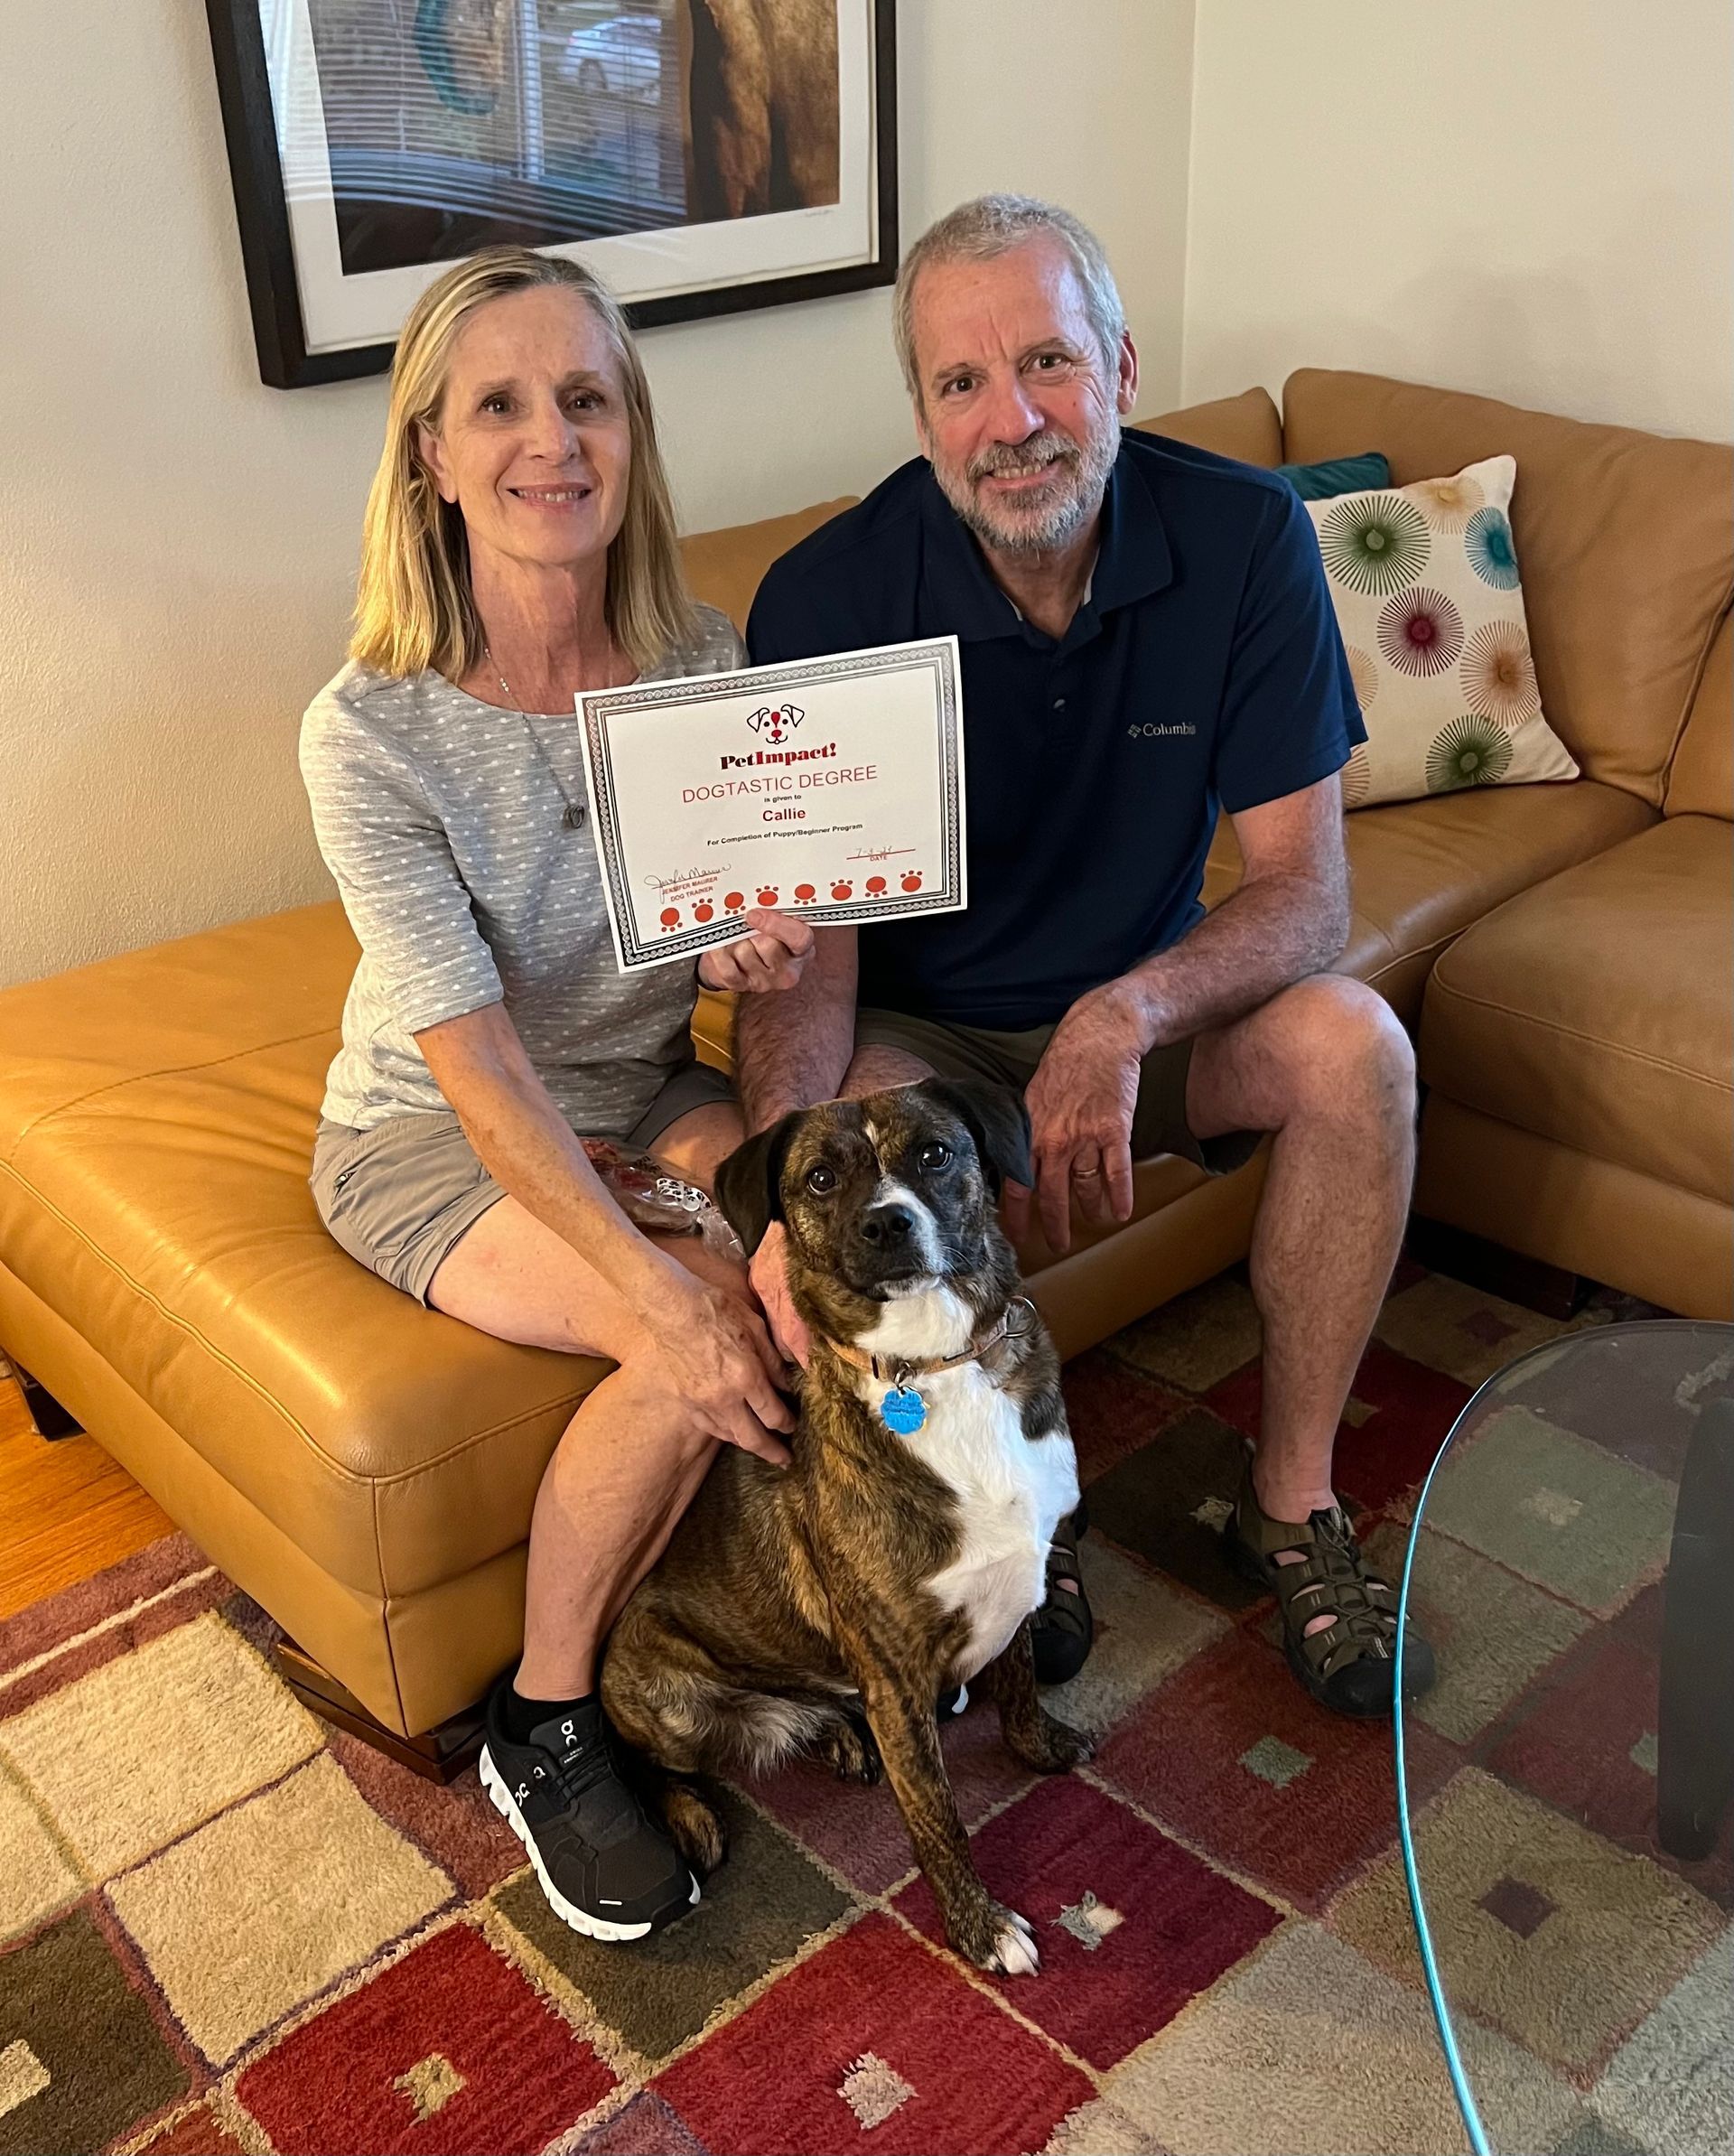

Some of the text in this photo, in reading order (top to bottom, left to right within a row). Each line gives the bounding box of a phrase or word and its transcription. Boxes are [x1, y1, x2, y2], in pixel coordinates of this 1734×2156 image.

[1142, 722, 1196, 736] Columbia
[720, 742, 836, 770] PetImpact!
[683, 765, 878, 803] DOGTASTIC DEGREE
[772, 795, 793, 803] given
[762, 808, 806, 822] Callie
[722, 833, 762, 845] Completion
[773, 827, 830, 838] Puppy/Beginner
[833, 823, 862, 833] Program
[670, 886, 713, 902] DOG TRAINER
